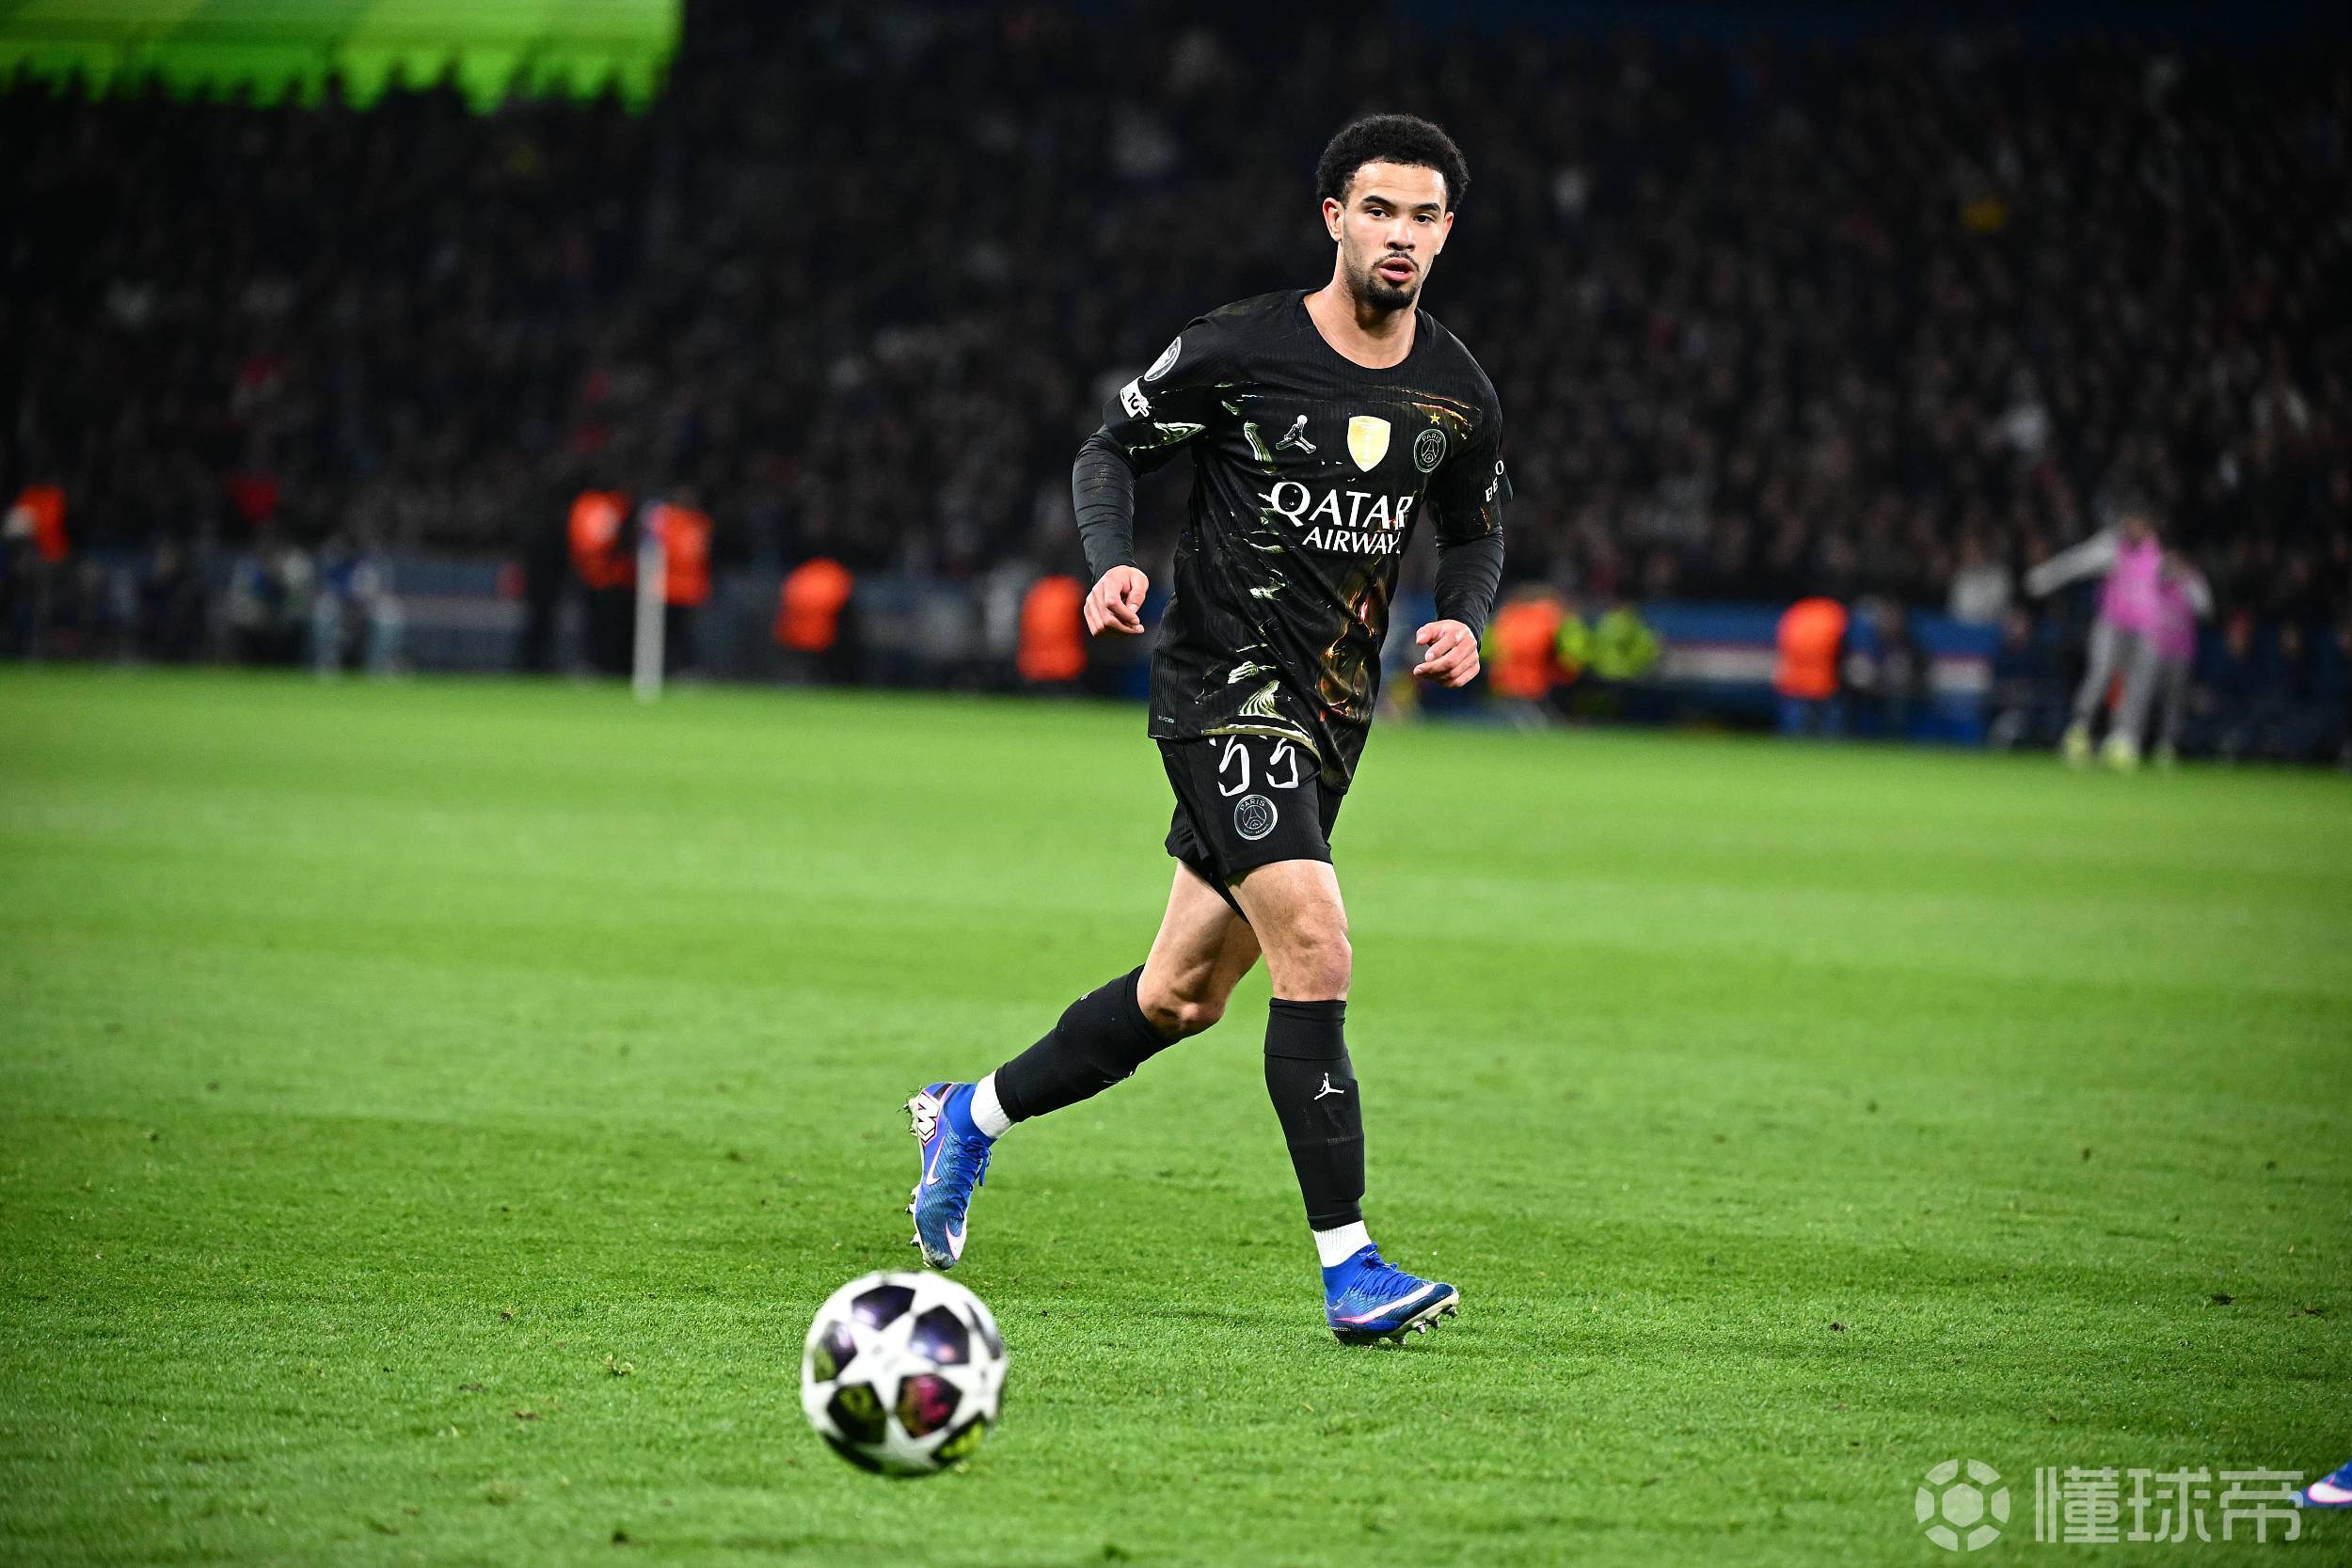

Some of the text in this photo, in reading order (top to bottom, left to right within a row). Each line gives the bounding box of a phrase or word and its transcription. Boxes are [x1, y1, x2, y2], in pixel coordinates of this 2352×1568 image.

[1422, 433, 1441, 445] PARIS
[1270, 482, 1414, 531] QATAR
[1302, 526, 1401, 555] AIRWAY
[1239, 798, 1266, 812] PARIS
